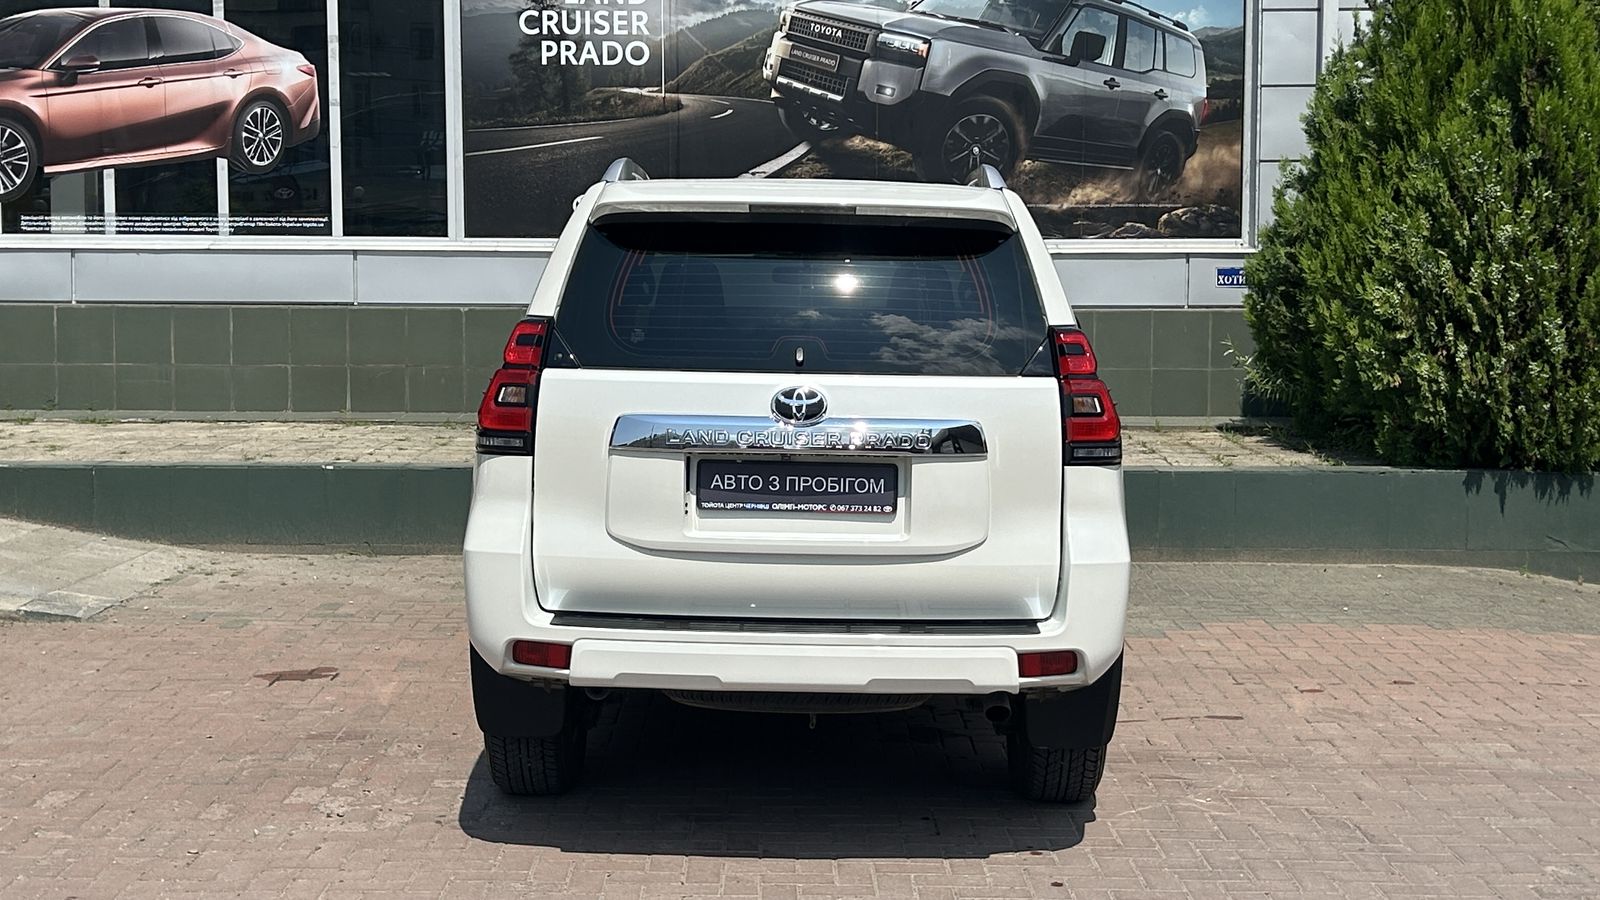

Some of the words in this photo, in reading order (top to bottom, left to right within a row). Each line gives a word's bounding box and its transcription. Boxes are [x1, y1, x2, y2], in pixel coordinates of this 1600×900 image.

[518, 9, 650, 36] CRUISER
[811, 23, 842, 38] TOYOTA
[540, 40, 651, 67] PRADO
[791, 48, 802, 57] LAND
[802, 51, 820, 62] CRUISER
[820, 57, 836, 66] PRADO
[1217, 274, 1246, 285] ХОТИ
[666, 427, 731, 446] LAND
[736, 429, 843, 449] CRUISER
[850, 431, 933, 451] PRADO
[710, 474, 763, 491] АВТО
[785, 476, 885, 494] ПРОБІГОМ
[701, 501, 724, 509] ТОЙОТА
[725, 502, 743, 510] ЦЕНТР
[771, 503, 828, 511] ОЛІМП-МОТОРС
[836, 504, 849, 512] 067
